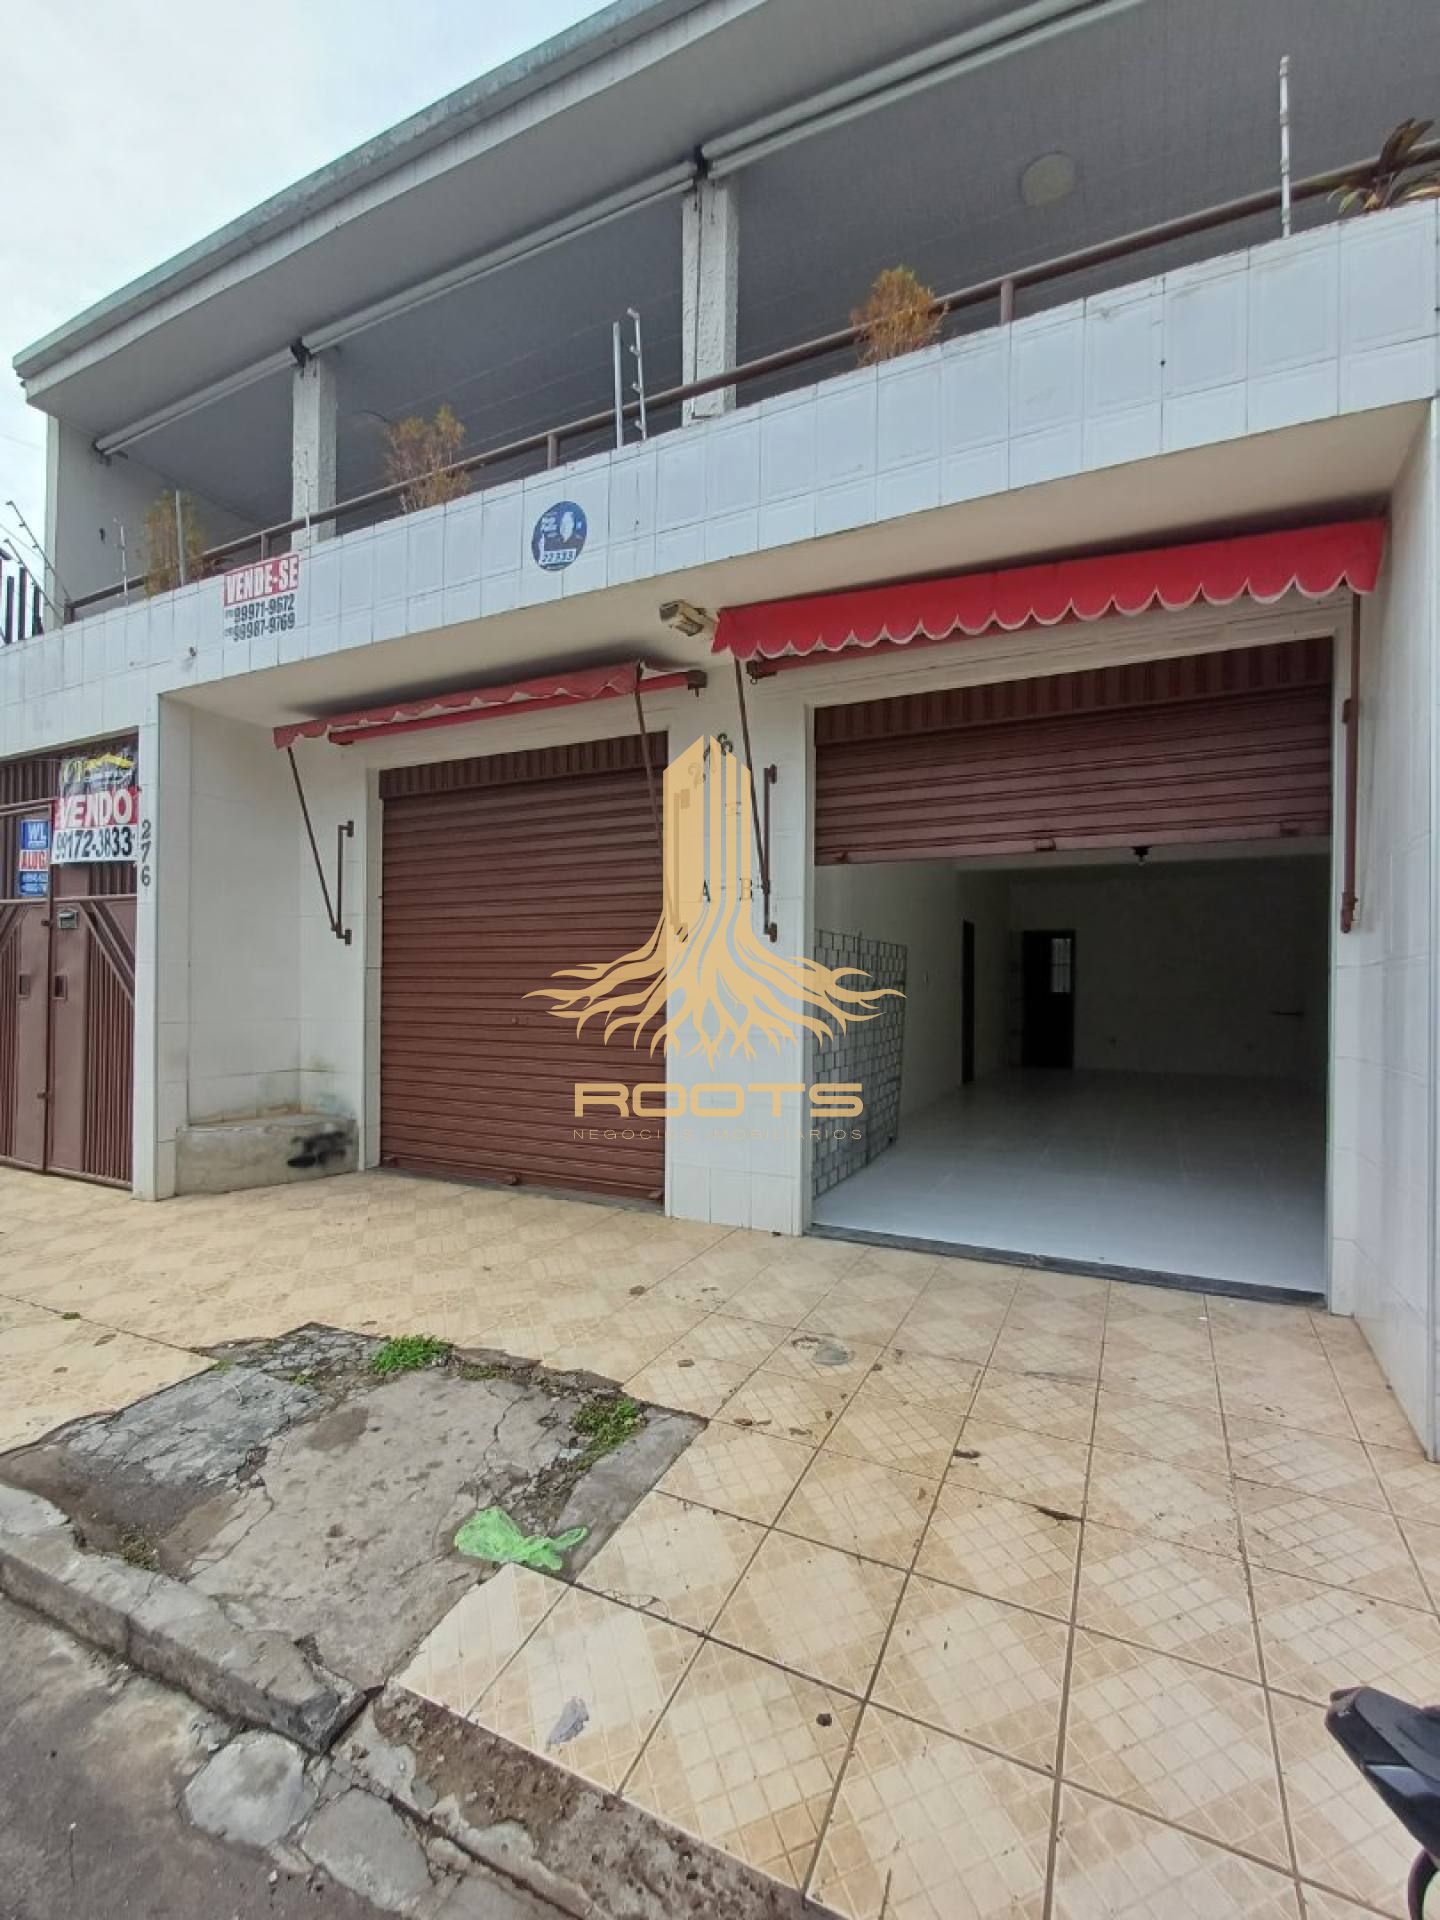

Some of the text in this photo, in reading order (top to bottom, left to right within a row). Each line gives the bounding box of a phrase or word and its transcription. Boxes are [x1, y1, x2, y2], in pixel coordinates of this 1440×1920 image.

[227, 557, 298, 604] VENDE-SE
[58, 788, 132, 830] VENDO
[20, 850, 48, 869] ALUG
[140, 818, 152, 887] 276
